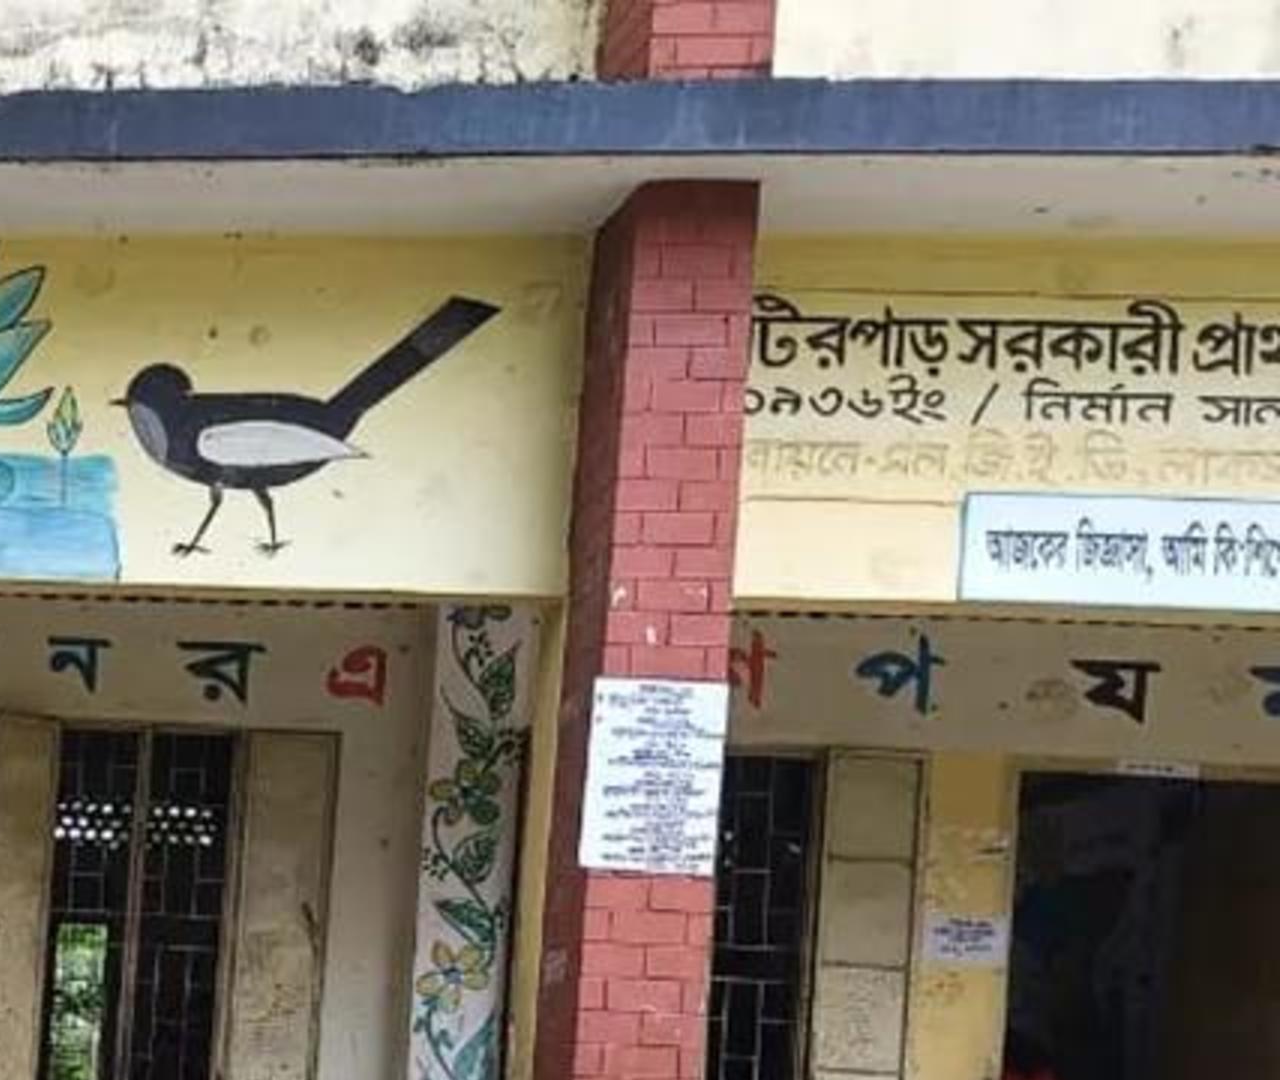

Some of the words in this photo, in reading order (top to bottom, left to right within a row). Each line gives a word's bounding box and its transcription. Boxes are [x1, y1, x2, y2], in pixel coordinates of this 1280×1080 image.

[956, 299, 1185, 376] সরকারী
[1021, 377, 1175, 424] নির্মান
[48, 636, 111, 693] ন
[177, 640, 267, 706] র
[854, 634, 946, 715] প
